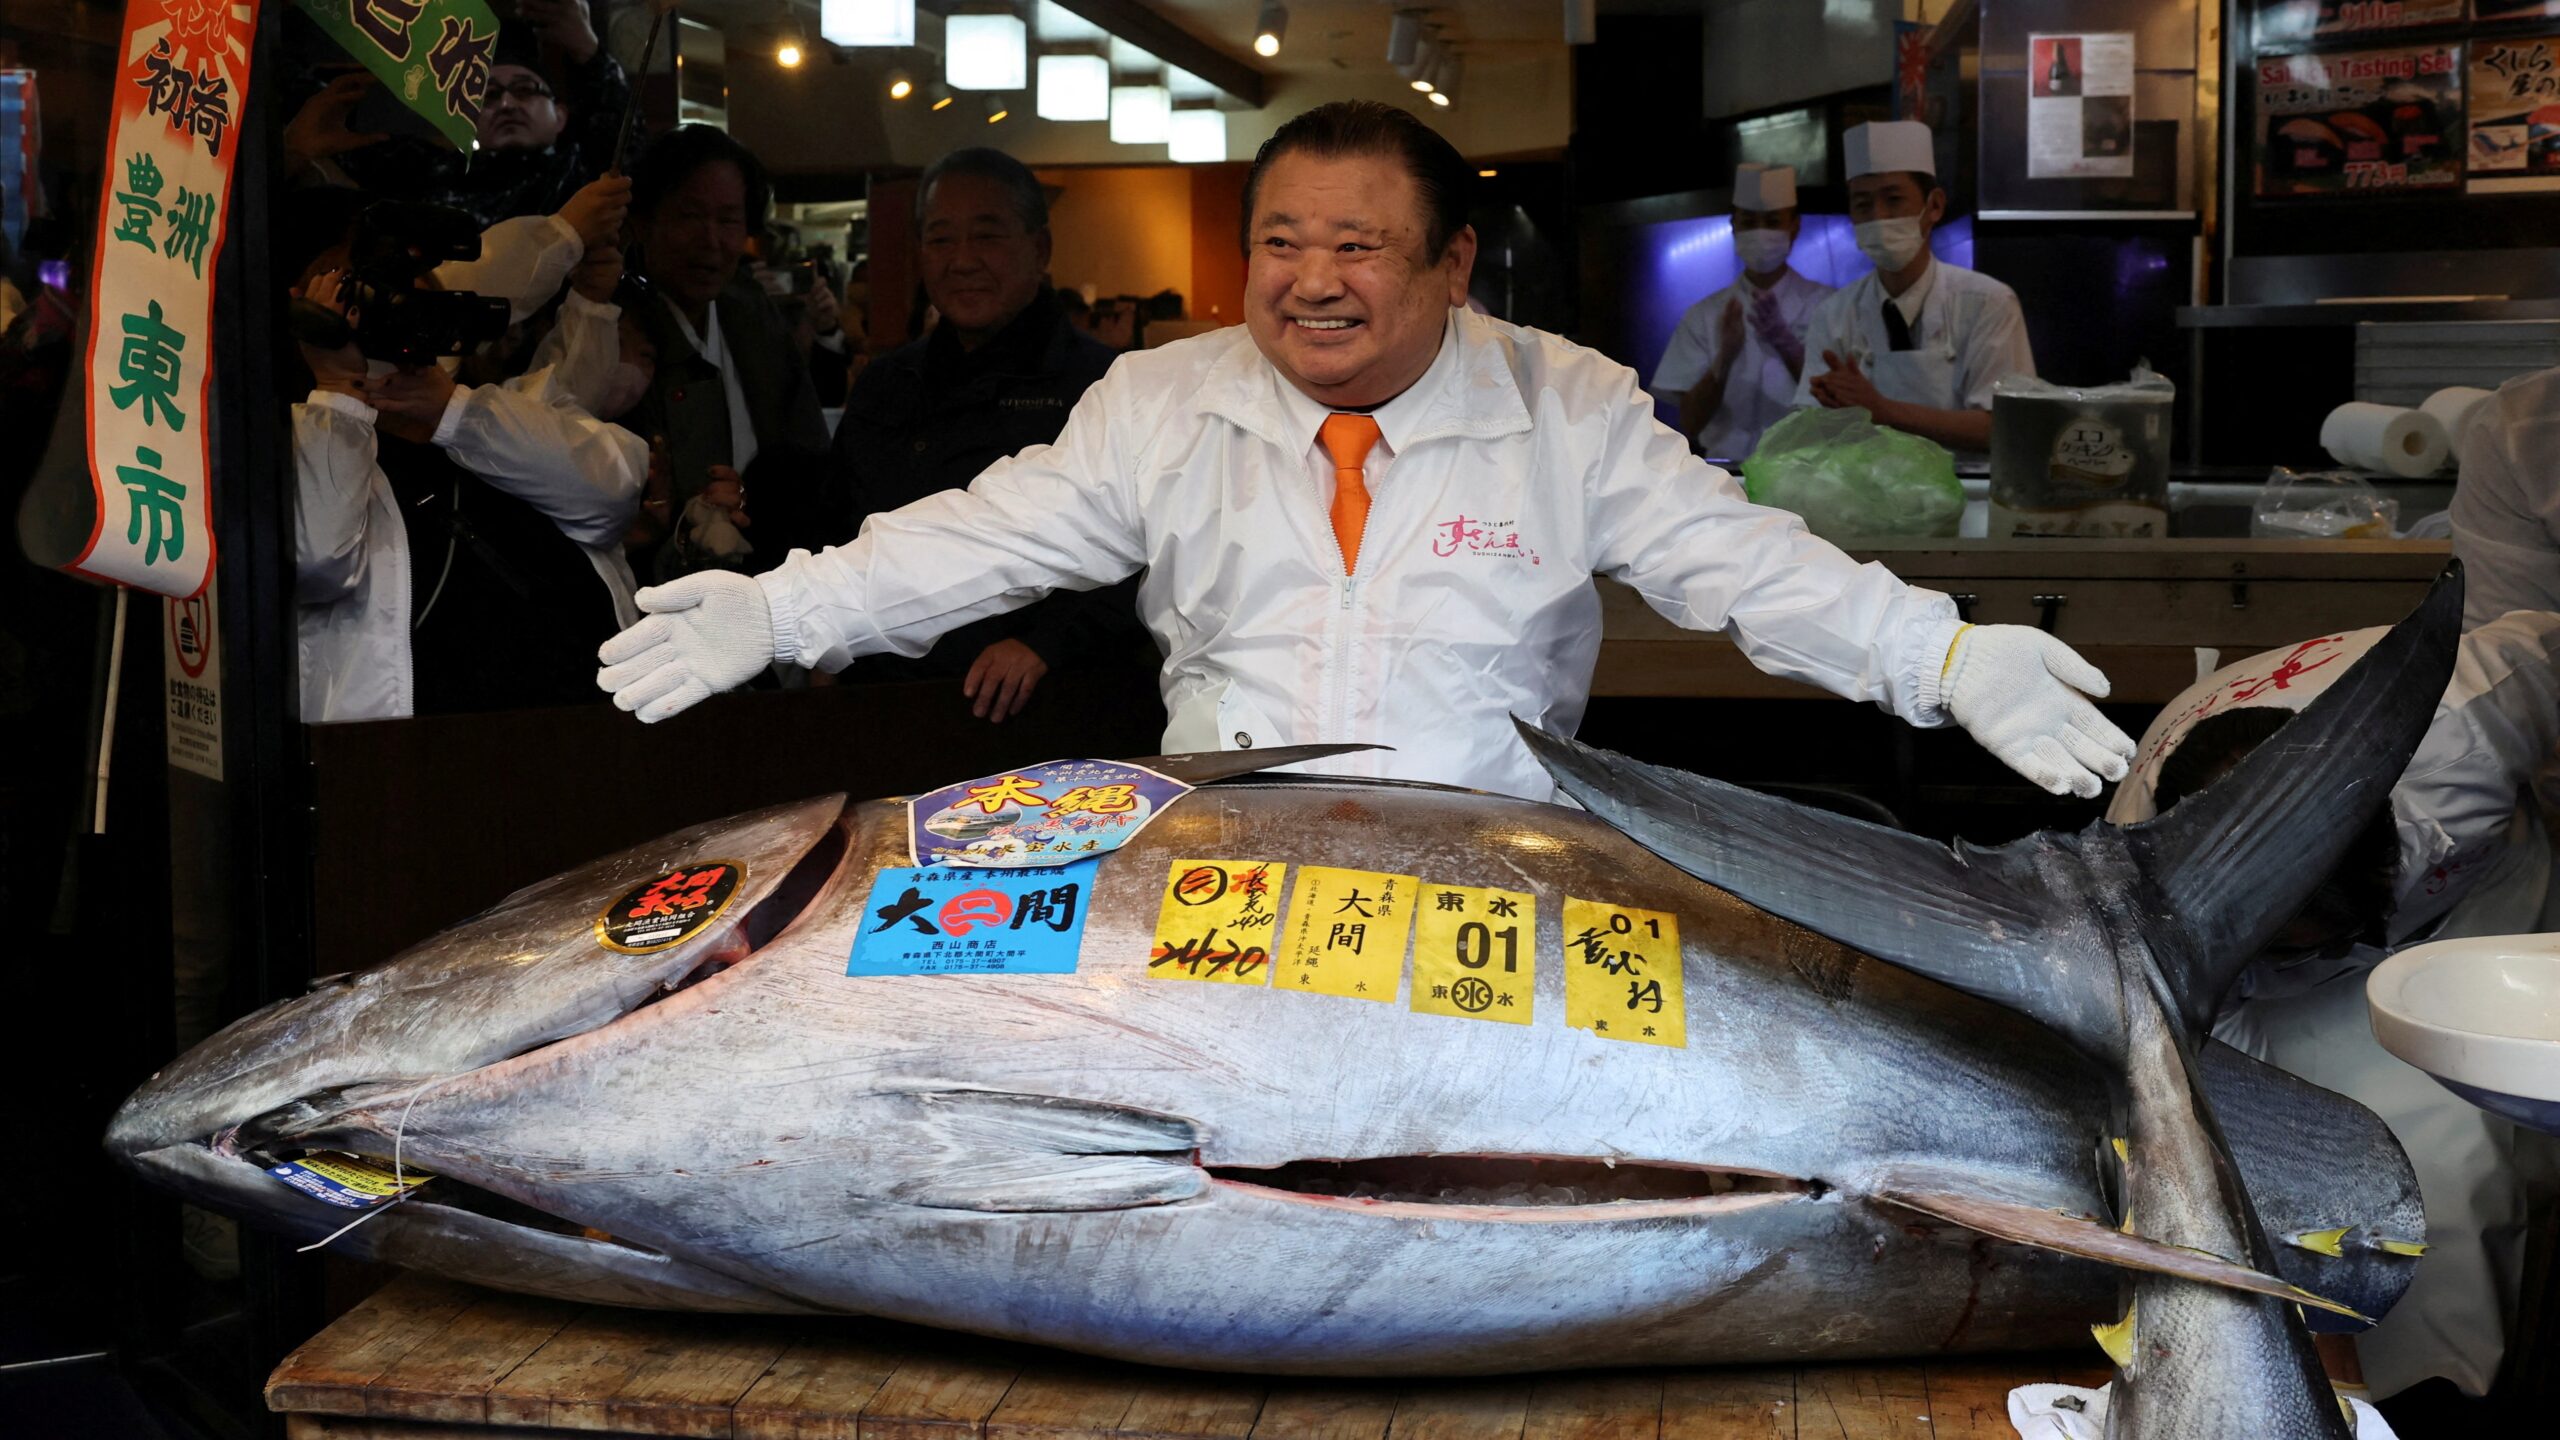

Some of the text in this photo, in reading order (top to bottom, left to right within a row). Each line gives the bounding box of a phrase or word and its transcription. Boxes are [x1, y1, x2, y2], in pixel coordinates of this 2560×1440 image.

[2262, 52, 2454, 85] Saln Tasting Set
[133, 37, 229, 157] 初荷
[114, 152, 217, 280] 豊洲
[108, 299, 187, 567] 東市
[2073, 429, 2104, 443] エコ
[1377, 878, 1399, 917] 青森県
[1326, 887, 1375, 956] 大間
[1609, 913, 1661, 940] 01
[931, 940, 998, 951] 西山商店
[1456, 921, 1519, 974] 01
[1299, 973, 1368, 993] 東 水
[1432, 984, 1515, 1007] 東 水
[1595, 1019, 1657, 1038] 東 水
